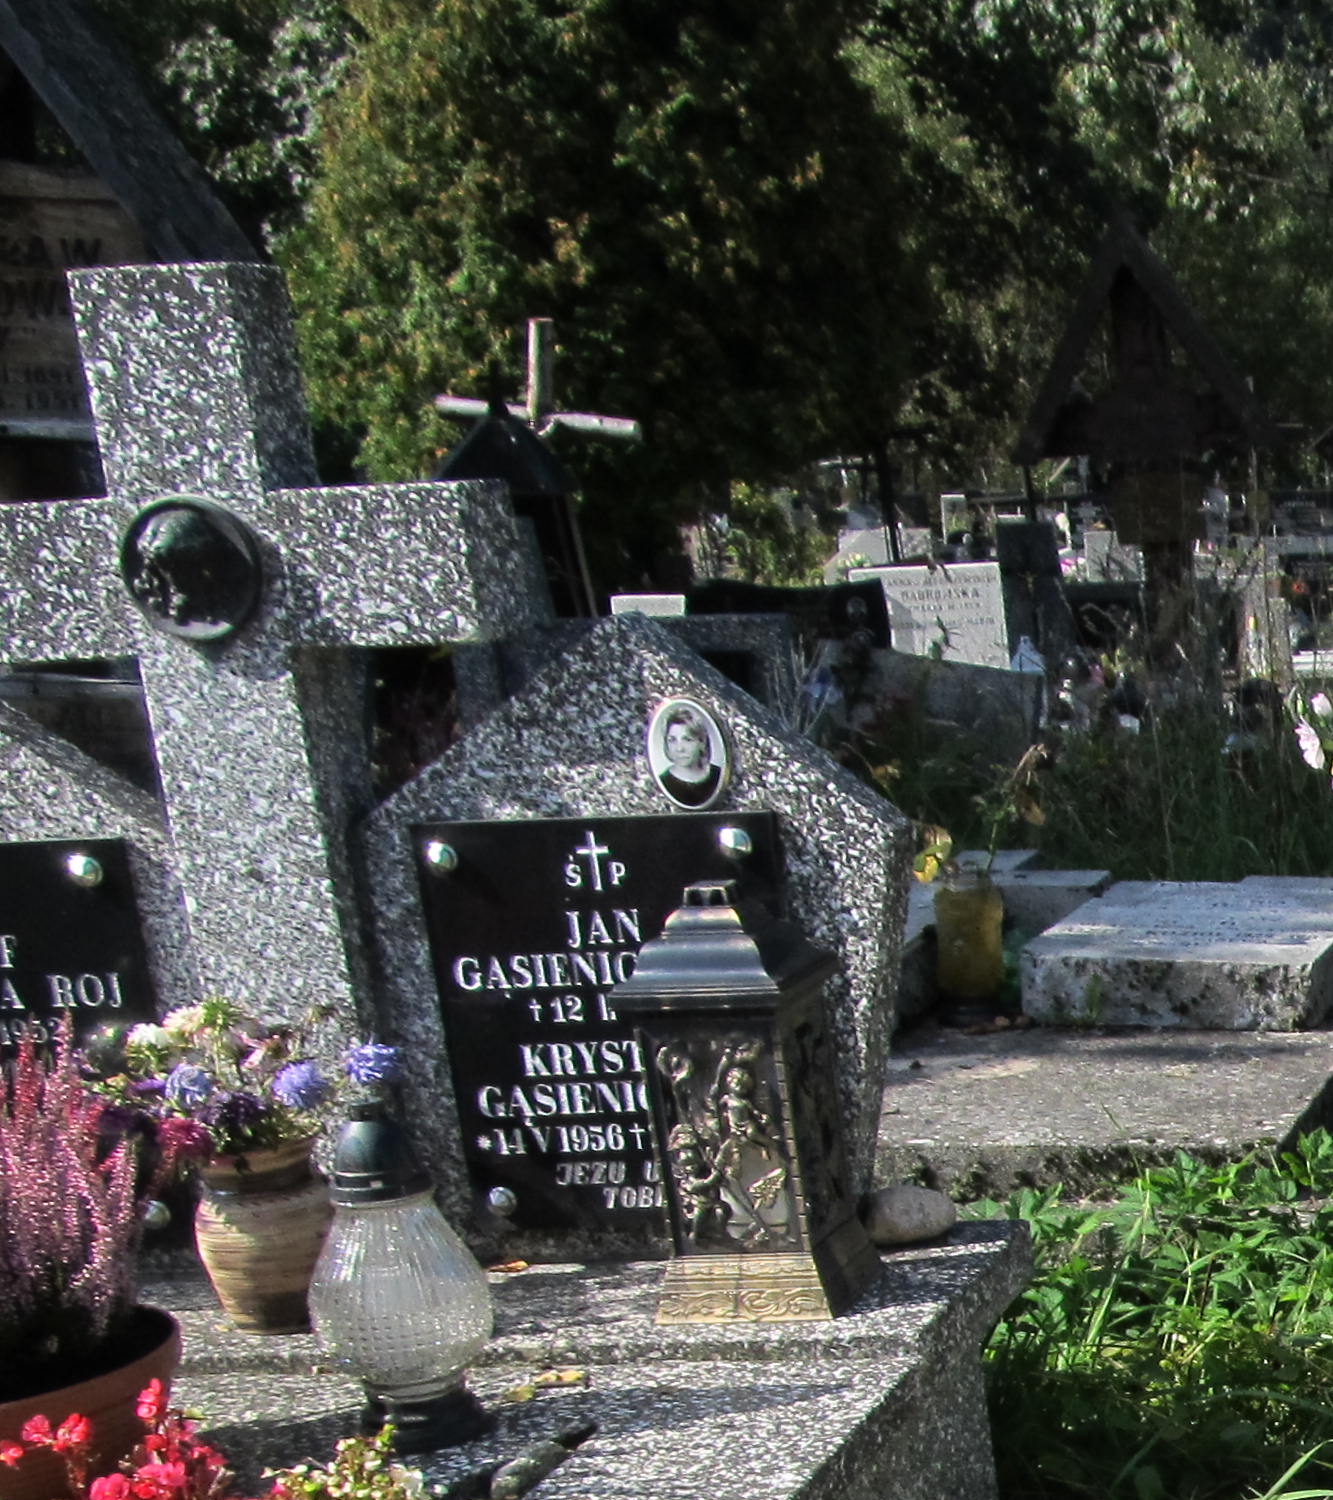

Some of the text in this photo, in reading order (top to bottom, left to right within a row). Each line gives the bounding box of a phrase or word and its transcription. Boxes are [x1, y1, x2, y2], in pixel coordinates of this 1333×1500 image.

[565, 907, 643, 949] JAN
[45, 972, 123, 1009] ROJ
[559, 1120, 626, 1153] 1956
[555, 1160, 628, 1188] JEZU
